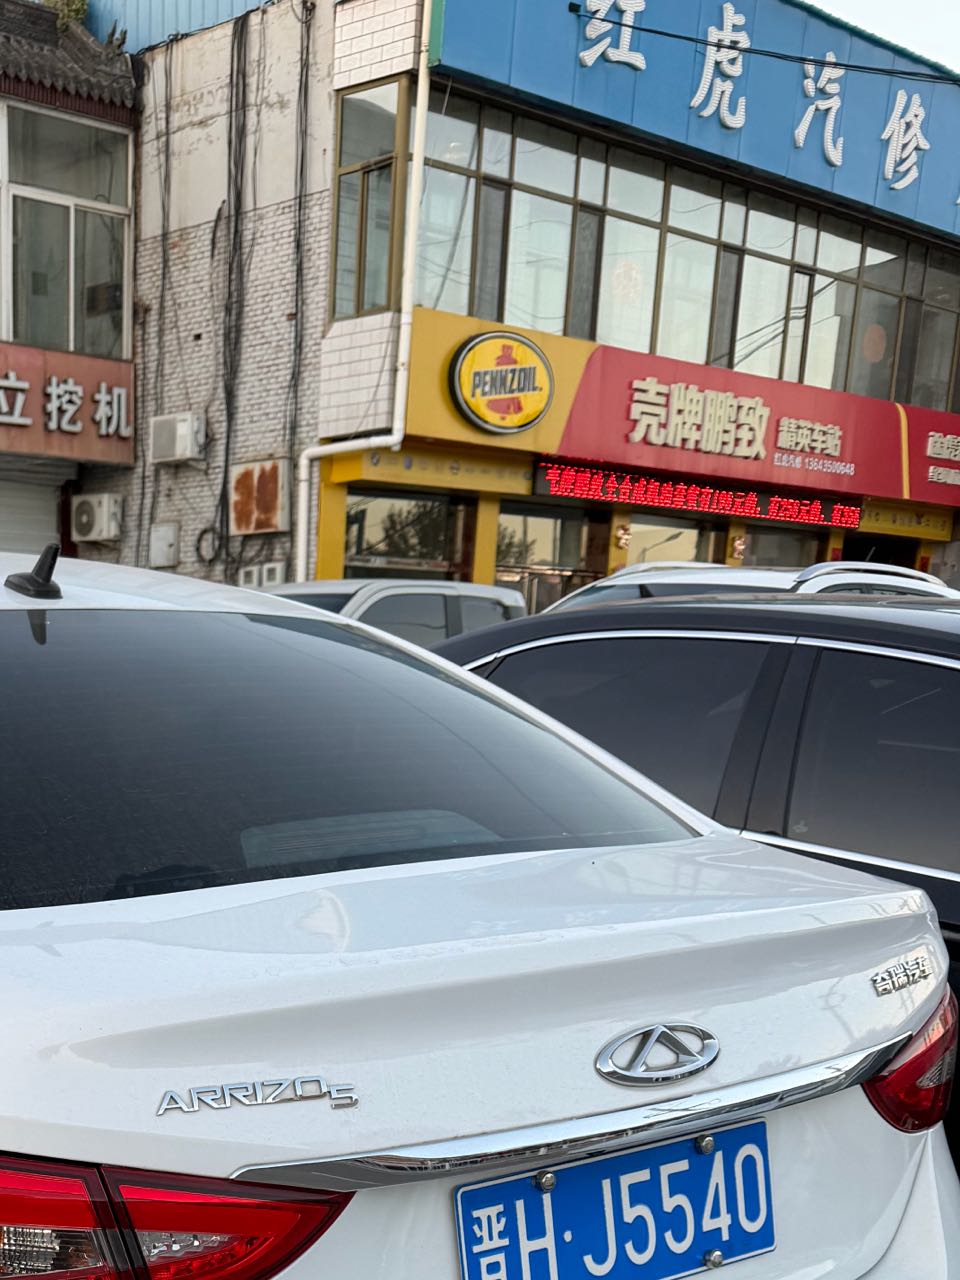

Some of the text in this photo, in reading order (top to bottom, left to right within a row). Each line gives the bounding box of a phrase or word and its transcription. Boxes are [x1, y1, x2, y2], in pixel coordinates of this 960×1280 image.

[471, 366, 539, 398] PENNZOIL
[629, 376, 770, 460] 壳牌鹏致
